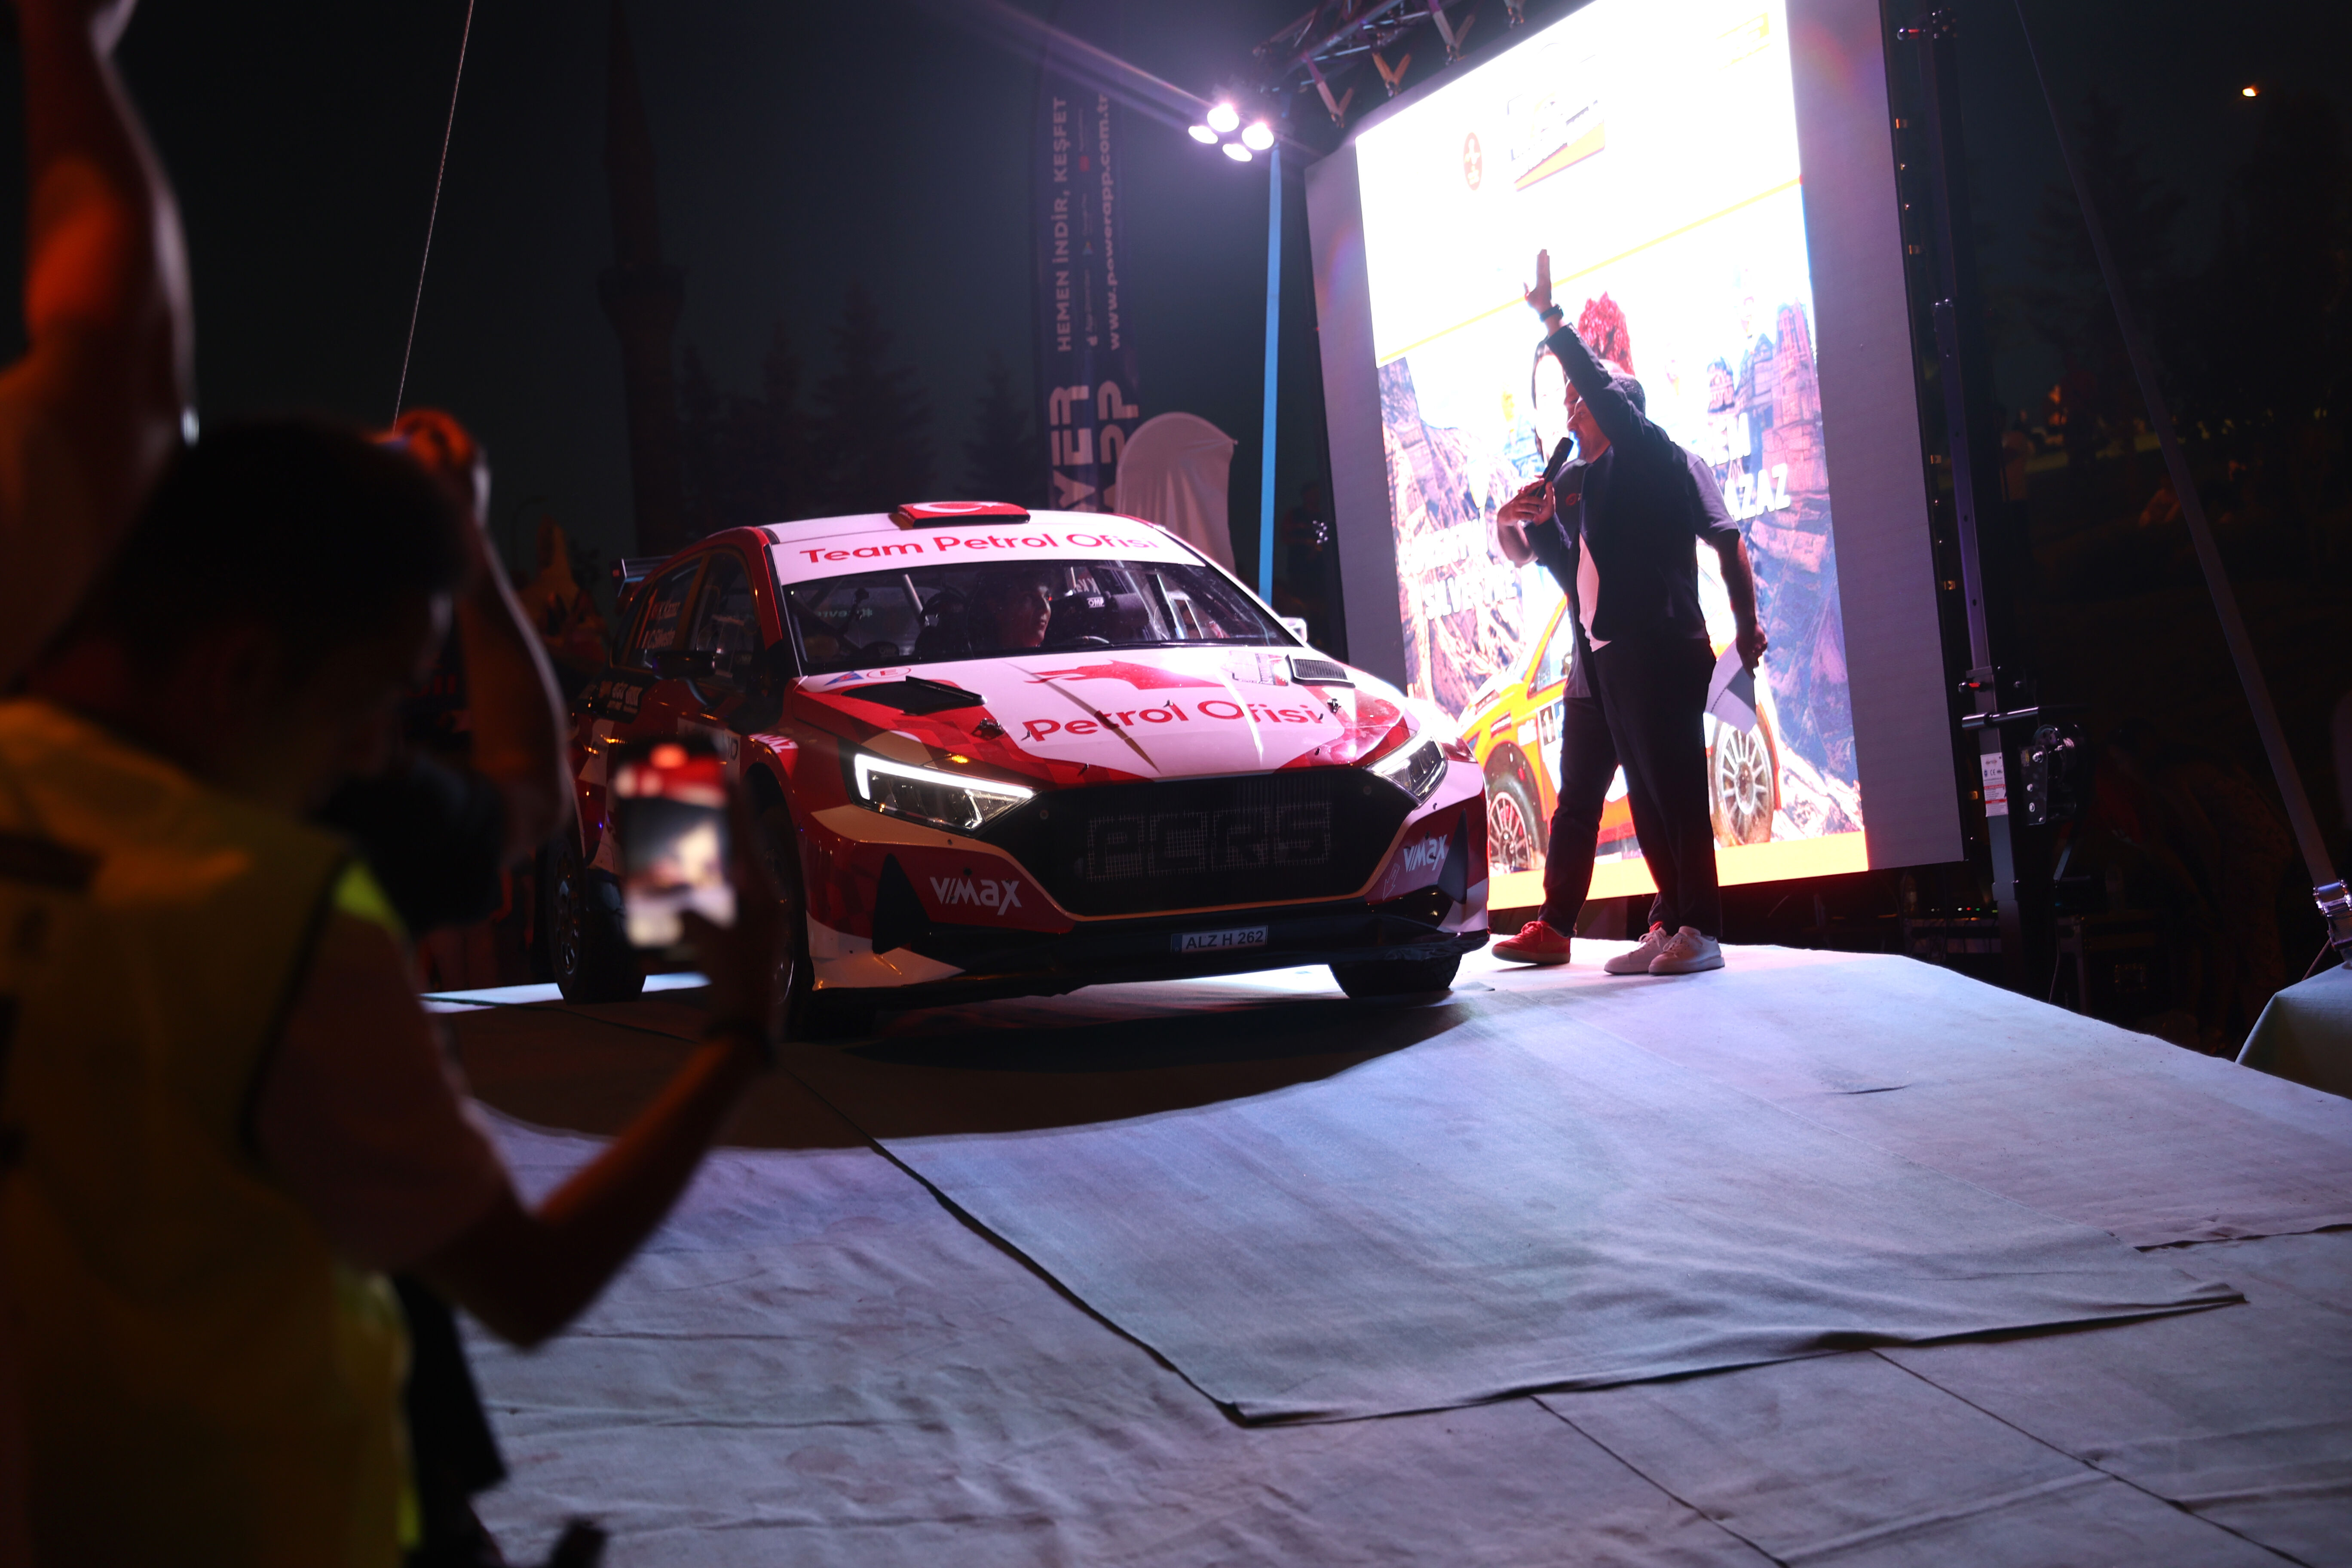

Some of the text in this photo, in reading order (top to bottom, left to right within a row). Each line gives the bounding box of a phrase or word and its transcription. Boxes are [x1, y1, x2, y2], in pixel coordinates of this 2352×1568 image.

[1050, 96, 1072, 352] HEMEN İNDİR, KEŞFET
[1096, 94, 1121, 351] www.powerapp.com.tr
[1724, 463, 1791, 521] AZAZ
[799, 533, 1159, 564] Team Petrol Ofisi
[1022, 700, 1323, 742] Petrol Ofisi
[1185, 934, 1218, 949] ALZ
[1222, 933, 1233, 946] H
[1237, 930, 1264, 945] 262
